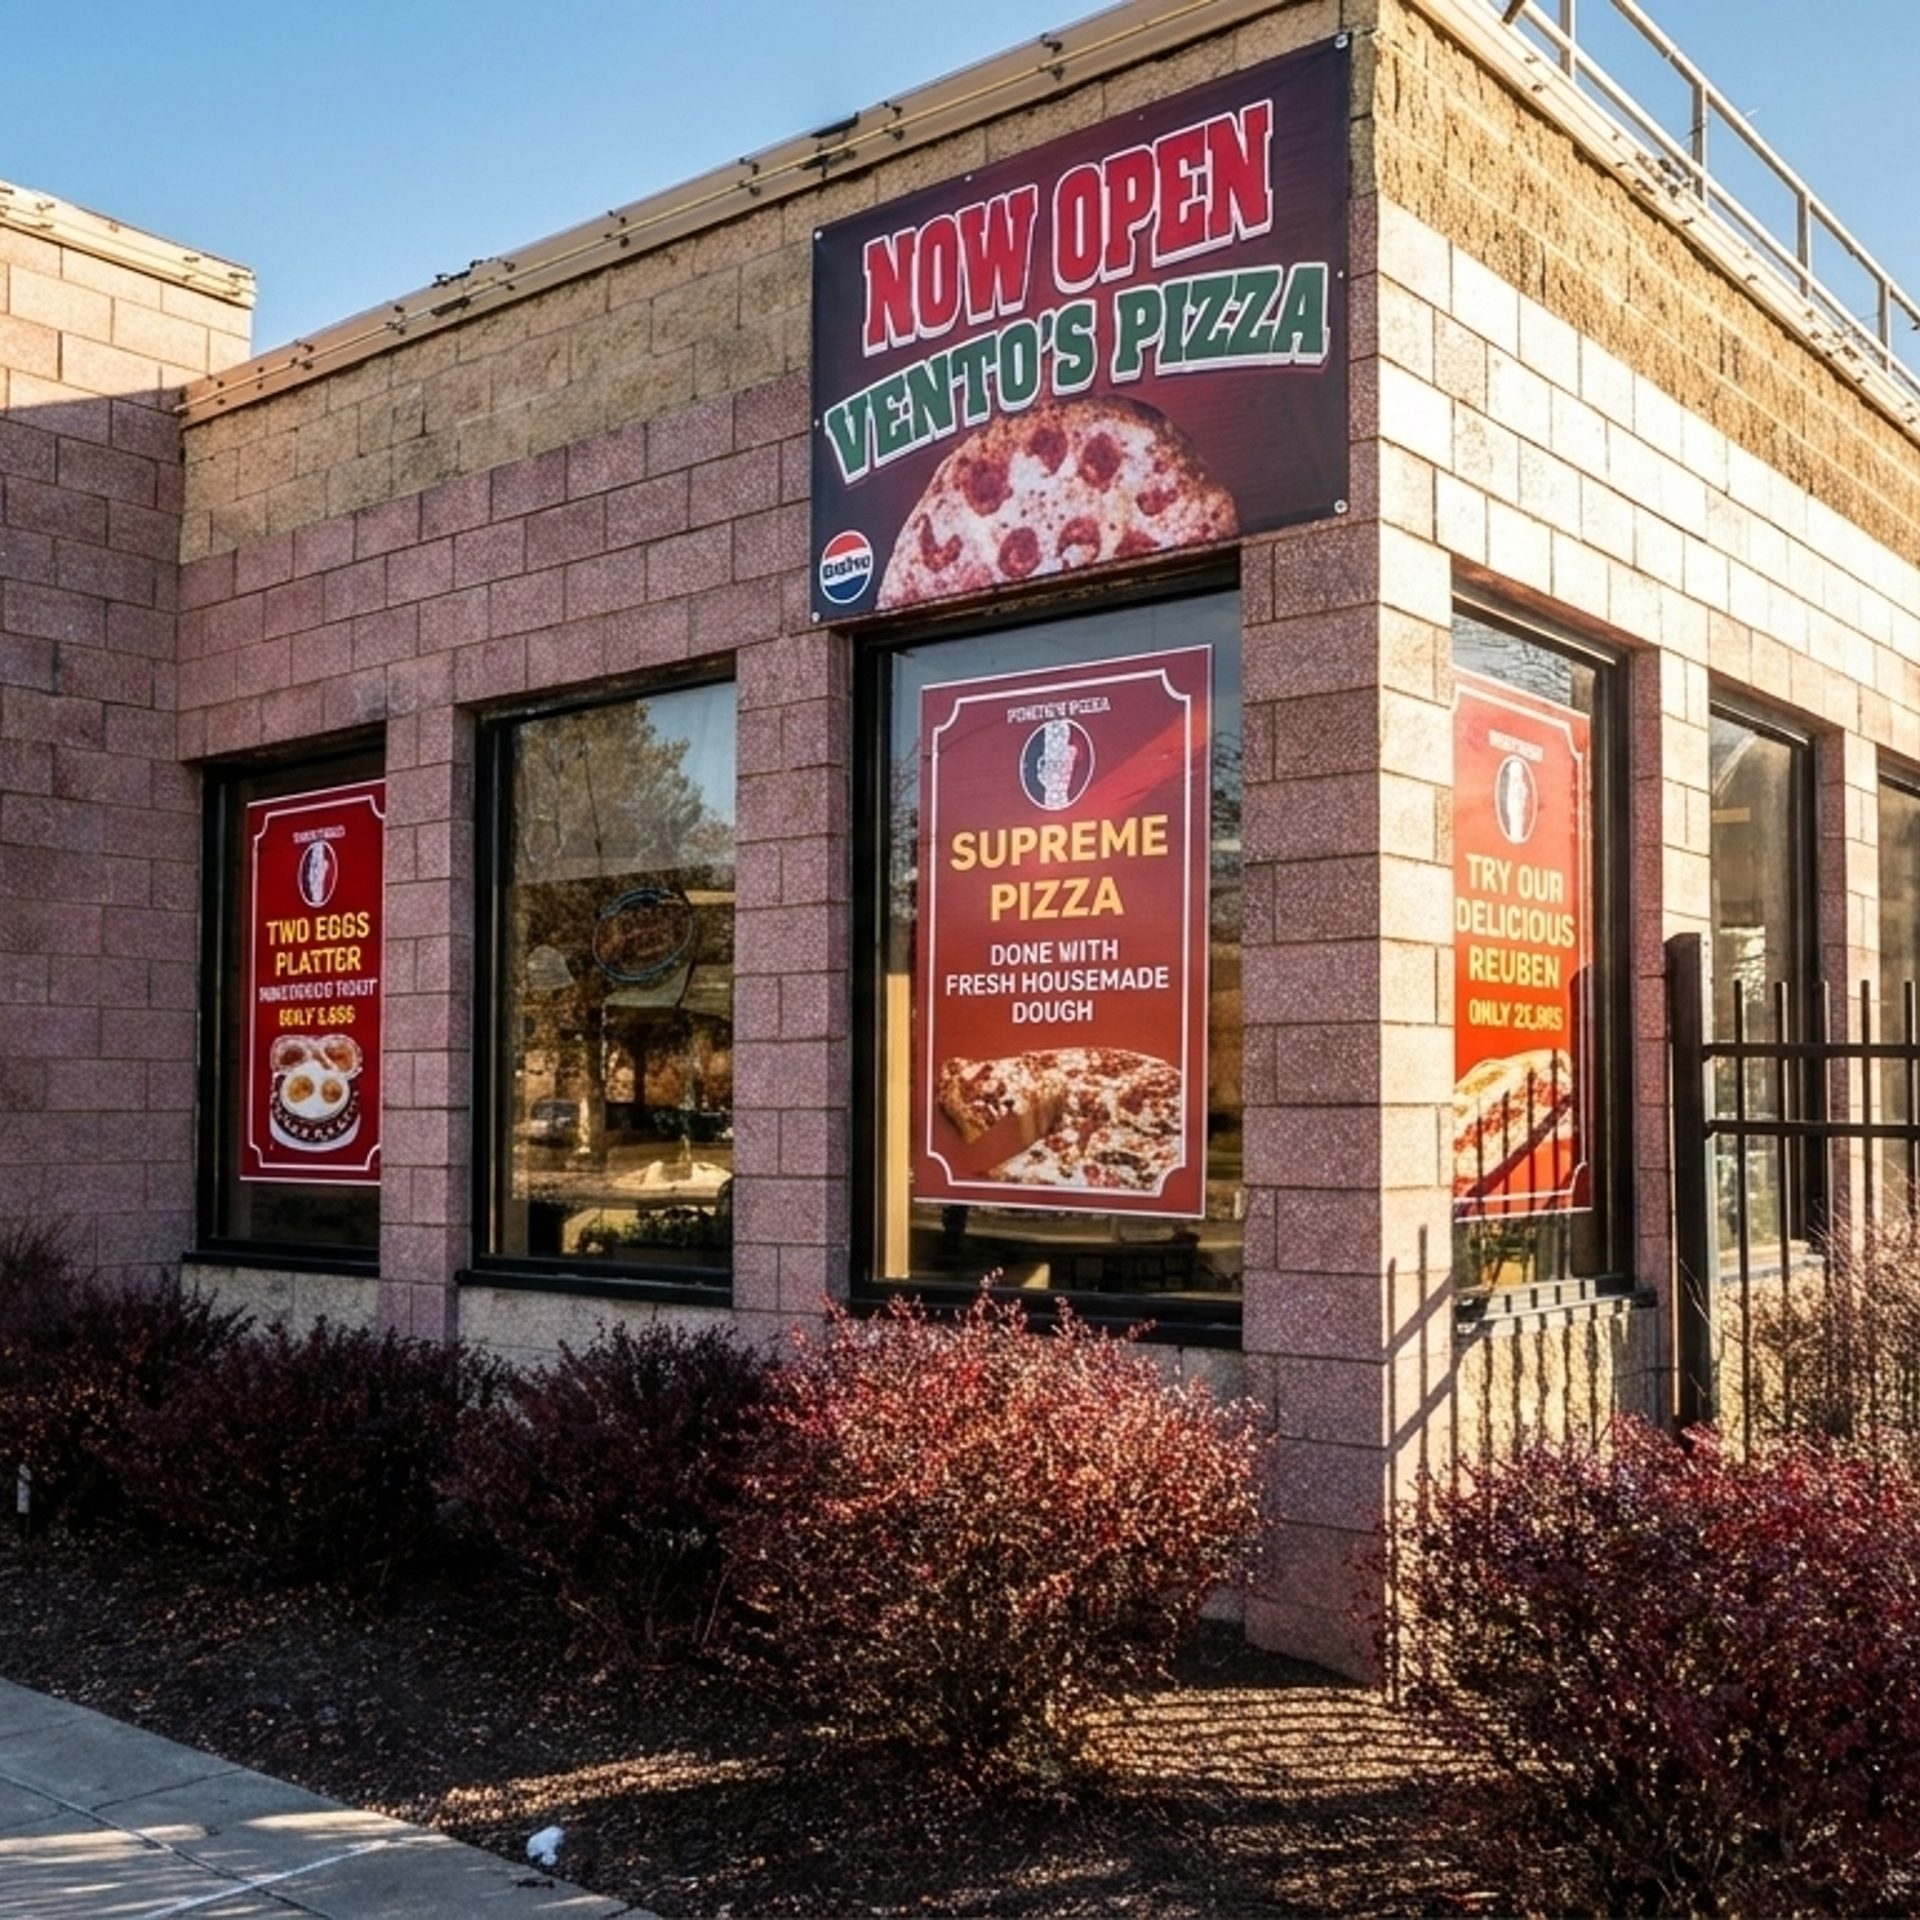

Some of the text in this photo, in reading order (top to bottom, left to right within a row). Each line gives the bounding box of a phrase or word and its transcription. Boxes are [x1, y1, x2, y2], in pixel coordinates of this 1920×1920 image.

[864, 99, 1272, 357] NOW OPEN
[823, 262, 1329, 483] VENTO'S PIZZA
[952, 815, 1169, 871] SUPREME
[990, 877, 1124, 922] PIZZA
[1465, 854, 1564, 904] TRY OUR
[266, 911, 370, 946] TWO EGGS
[1456, 897, 1576, 948] DELICIOUS
[275, 945, 362, 976] PLATTER
[991, 939, 1118, 966] DONE WITH
[1468, 944, 1560, 989] REUBEN
[946, 966, 1170, 997] FRESH HOUSEMADE
[1012, 1000, 1093, 1024] DOUGH
[1469, 998, 1511, 1027] ONLY
